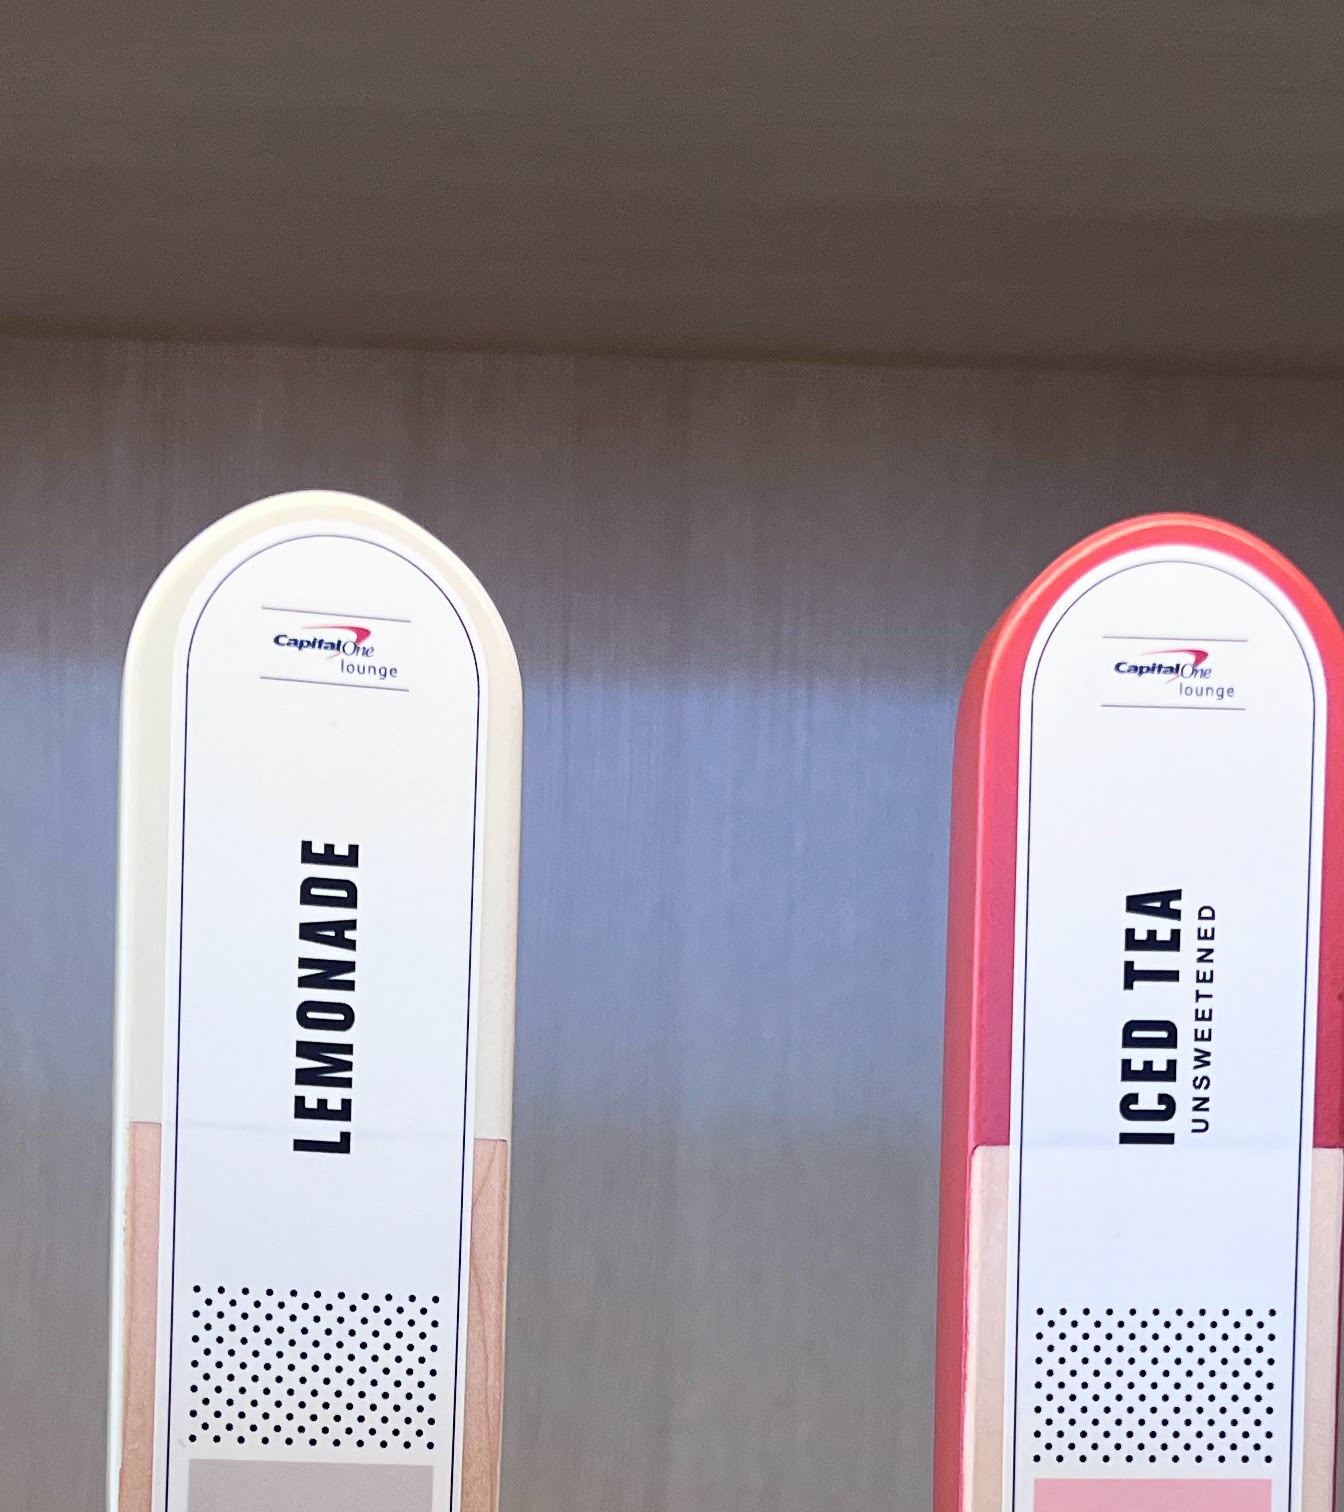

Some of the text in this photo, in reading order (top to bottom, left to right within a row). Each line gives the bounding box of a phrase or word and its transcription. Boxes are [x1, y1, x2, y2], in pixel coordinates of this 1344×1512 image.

[340, 658, 398, 680] lounge
[1179, 682, 1235, 700] lounge
[292, 840, 360, 1155] LEMONADE
[1118, 888, 1183, 1145] ICED TEA
[1191, 904, 1216, 1133] UNSWEETENED
